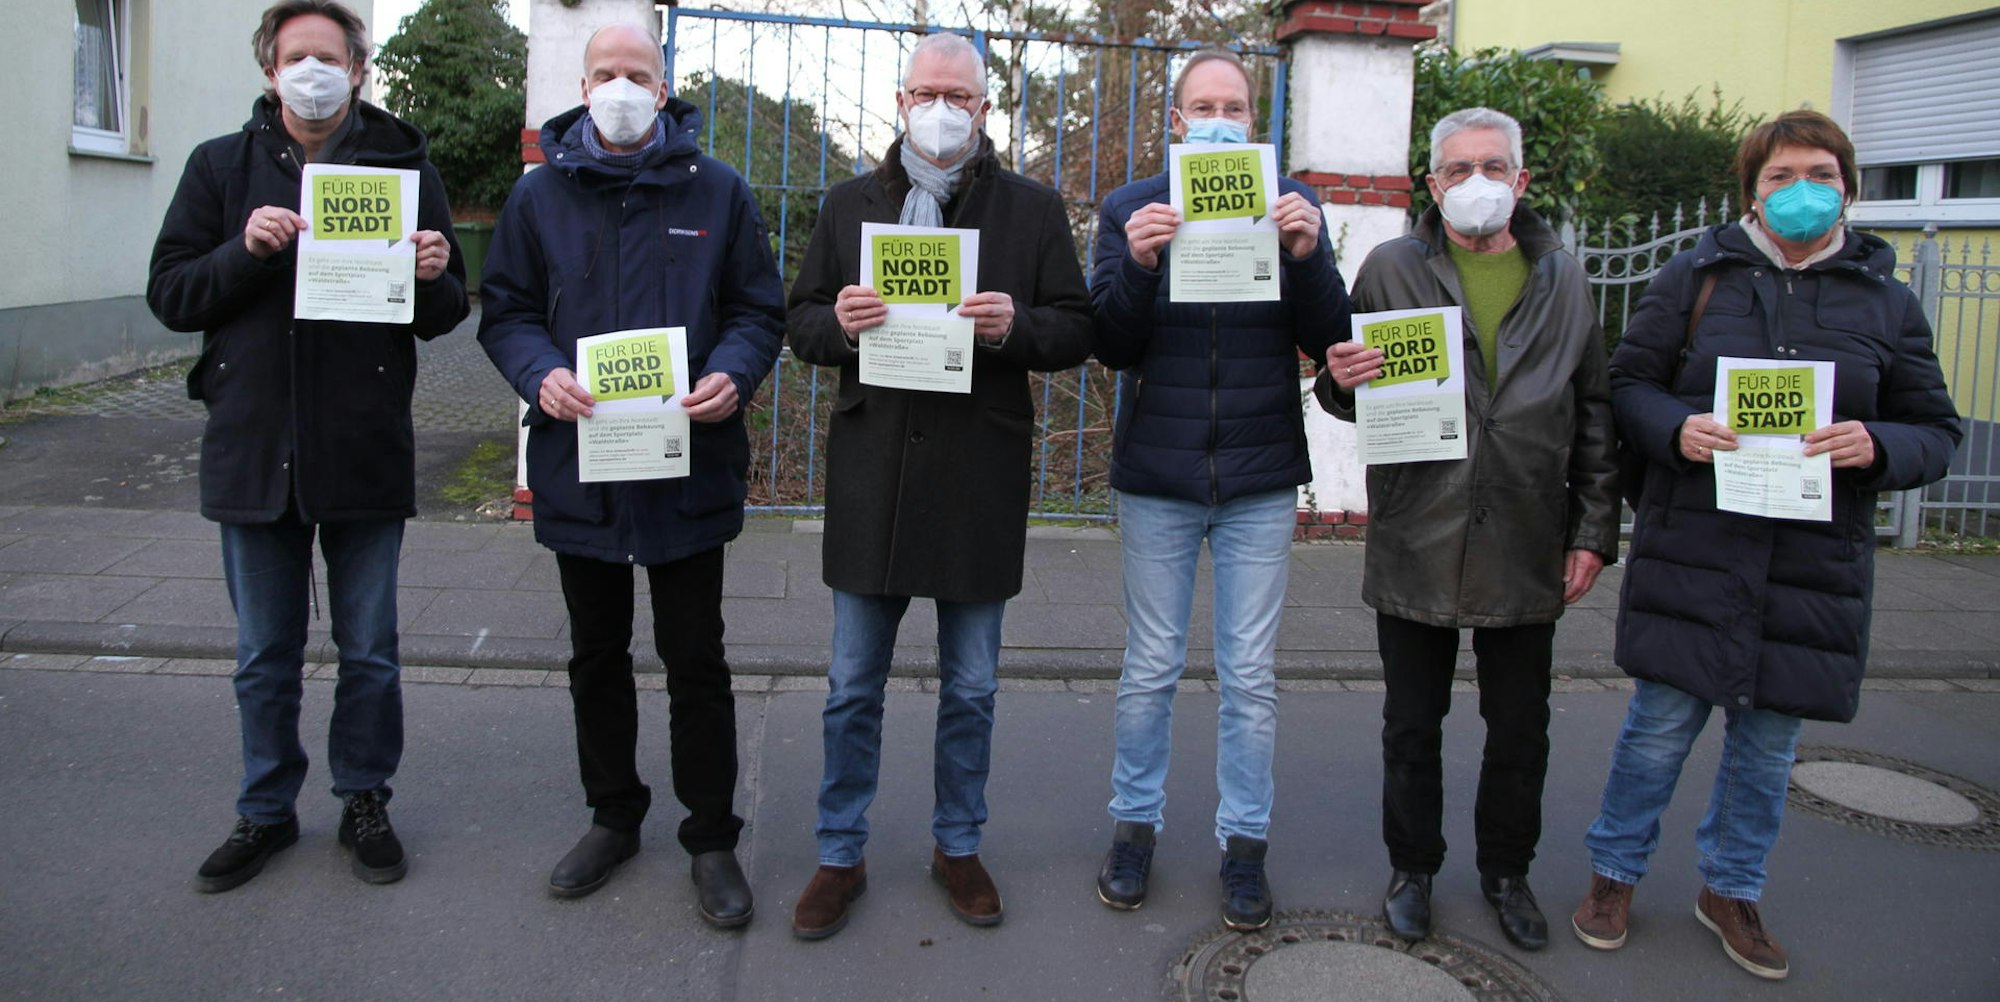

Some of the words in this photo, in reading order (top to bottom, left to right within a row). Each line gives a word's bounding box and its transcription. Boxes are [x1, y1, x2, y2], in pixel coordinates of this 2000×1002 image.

[1189, 158, 1220, 174] FÜR
[1225, 157, 1249, 172] DIE
[322, 179, 355, 194] FÜR
[362, 182, 387, 194] DIE
[1192, 174, 1253, 194] NORD
[323, 198, 390, 213] NORD
[1193, 193, 1256, 213] STADT
[323, 216, 392, 232] STADT
[881, 240, 914, 256] FÜR
[920, 242, 946, 256] DIE
[883, 259, 949, 276] NORD
[882, 279, 951, 296] STADT
[1372, 325, 1401, 342] FÜR
[1406, 322, 1432, 337] DIE
[596, 345, 626, 360] FÜR
[631, 341, 657, 354] DIE
[597, 355, 660, 376] NORD
[1376, 355, 1438, 379] STADT
[598, 372, 664, 393] STADT
[1738, 373, 1770, 389] FÜR
[1776, 375, 1800, 389] DIE
[1738, 392, 1803, 409] NORD
[1736, 410, 1806, 428] STADT
